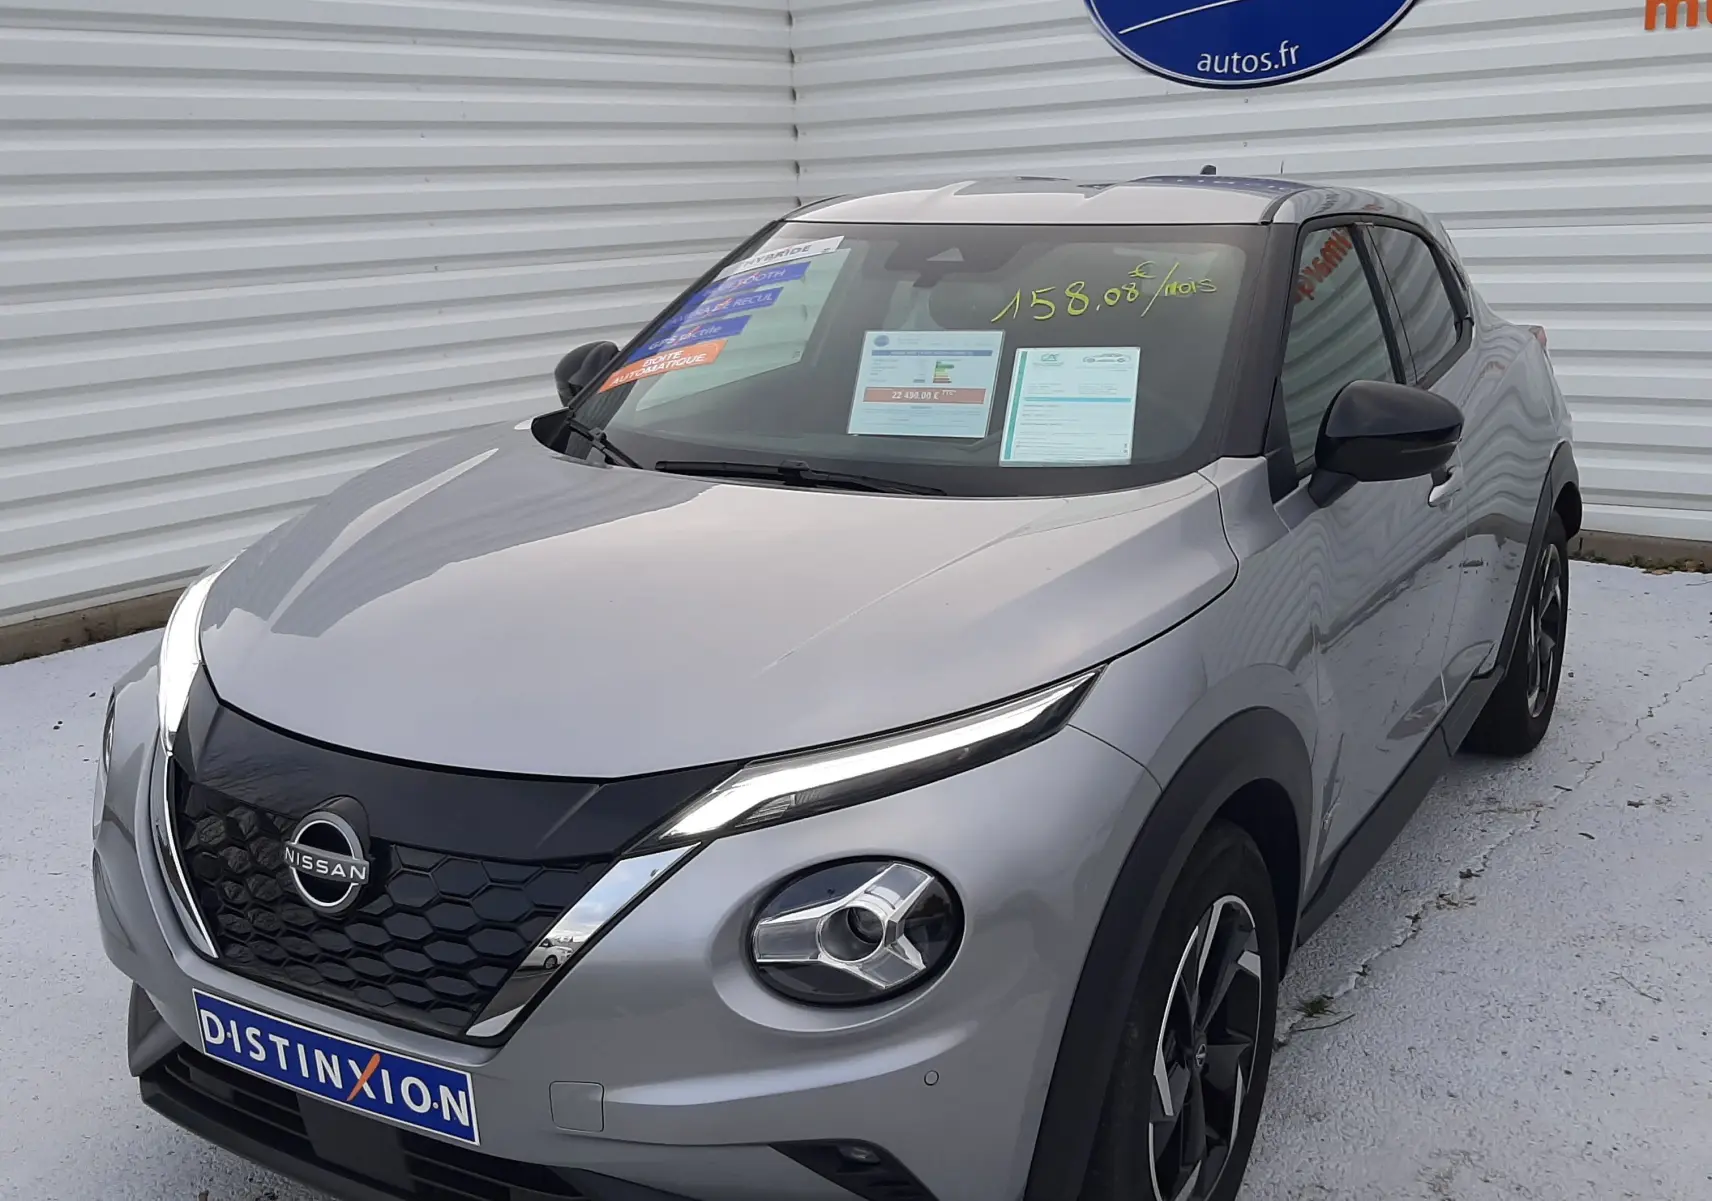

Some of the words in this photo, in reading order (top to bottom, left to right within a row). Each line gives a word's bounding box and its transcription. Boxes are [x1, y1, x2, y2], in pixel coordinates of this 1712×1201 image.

[1196, 40, 1300, 74] autos.fr
[733, 293, 774, 308] RECUL
[611, 353, 708, 385] AUTOMATIQUE
[643, 350, 685, 368] BOITE
[284, 846, 367, 881] NISSAN
